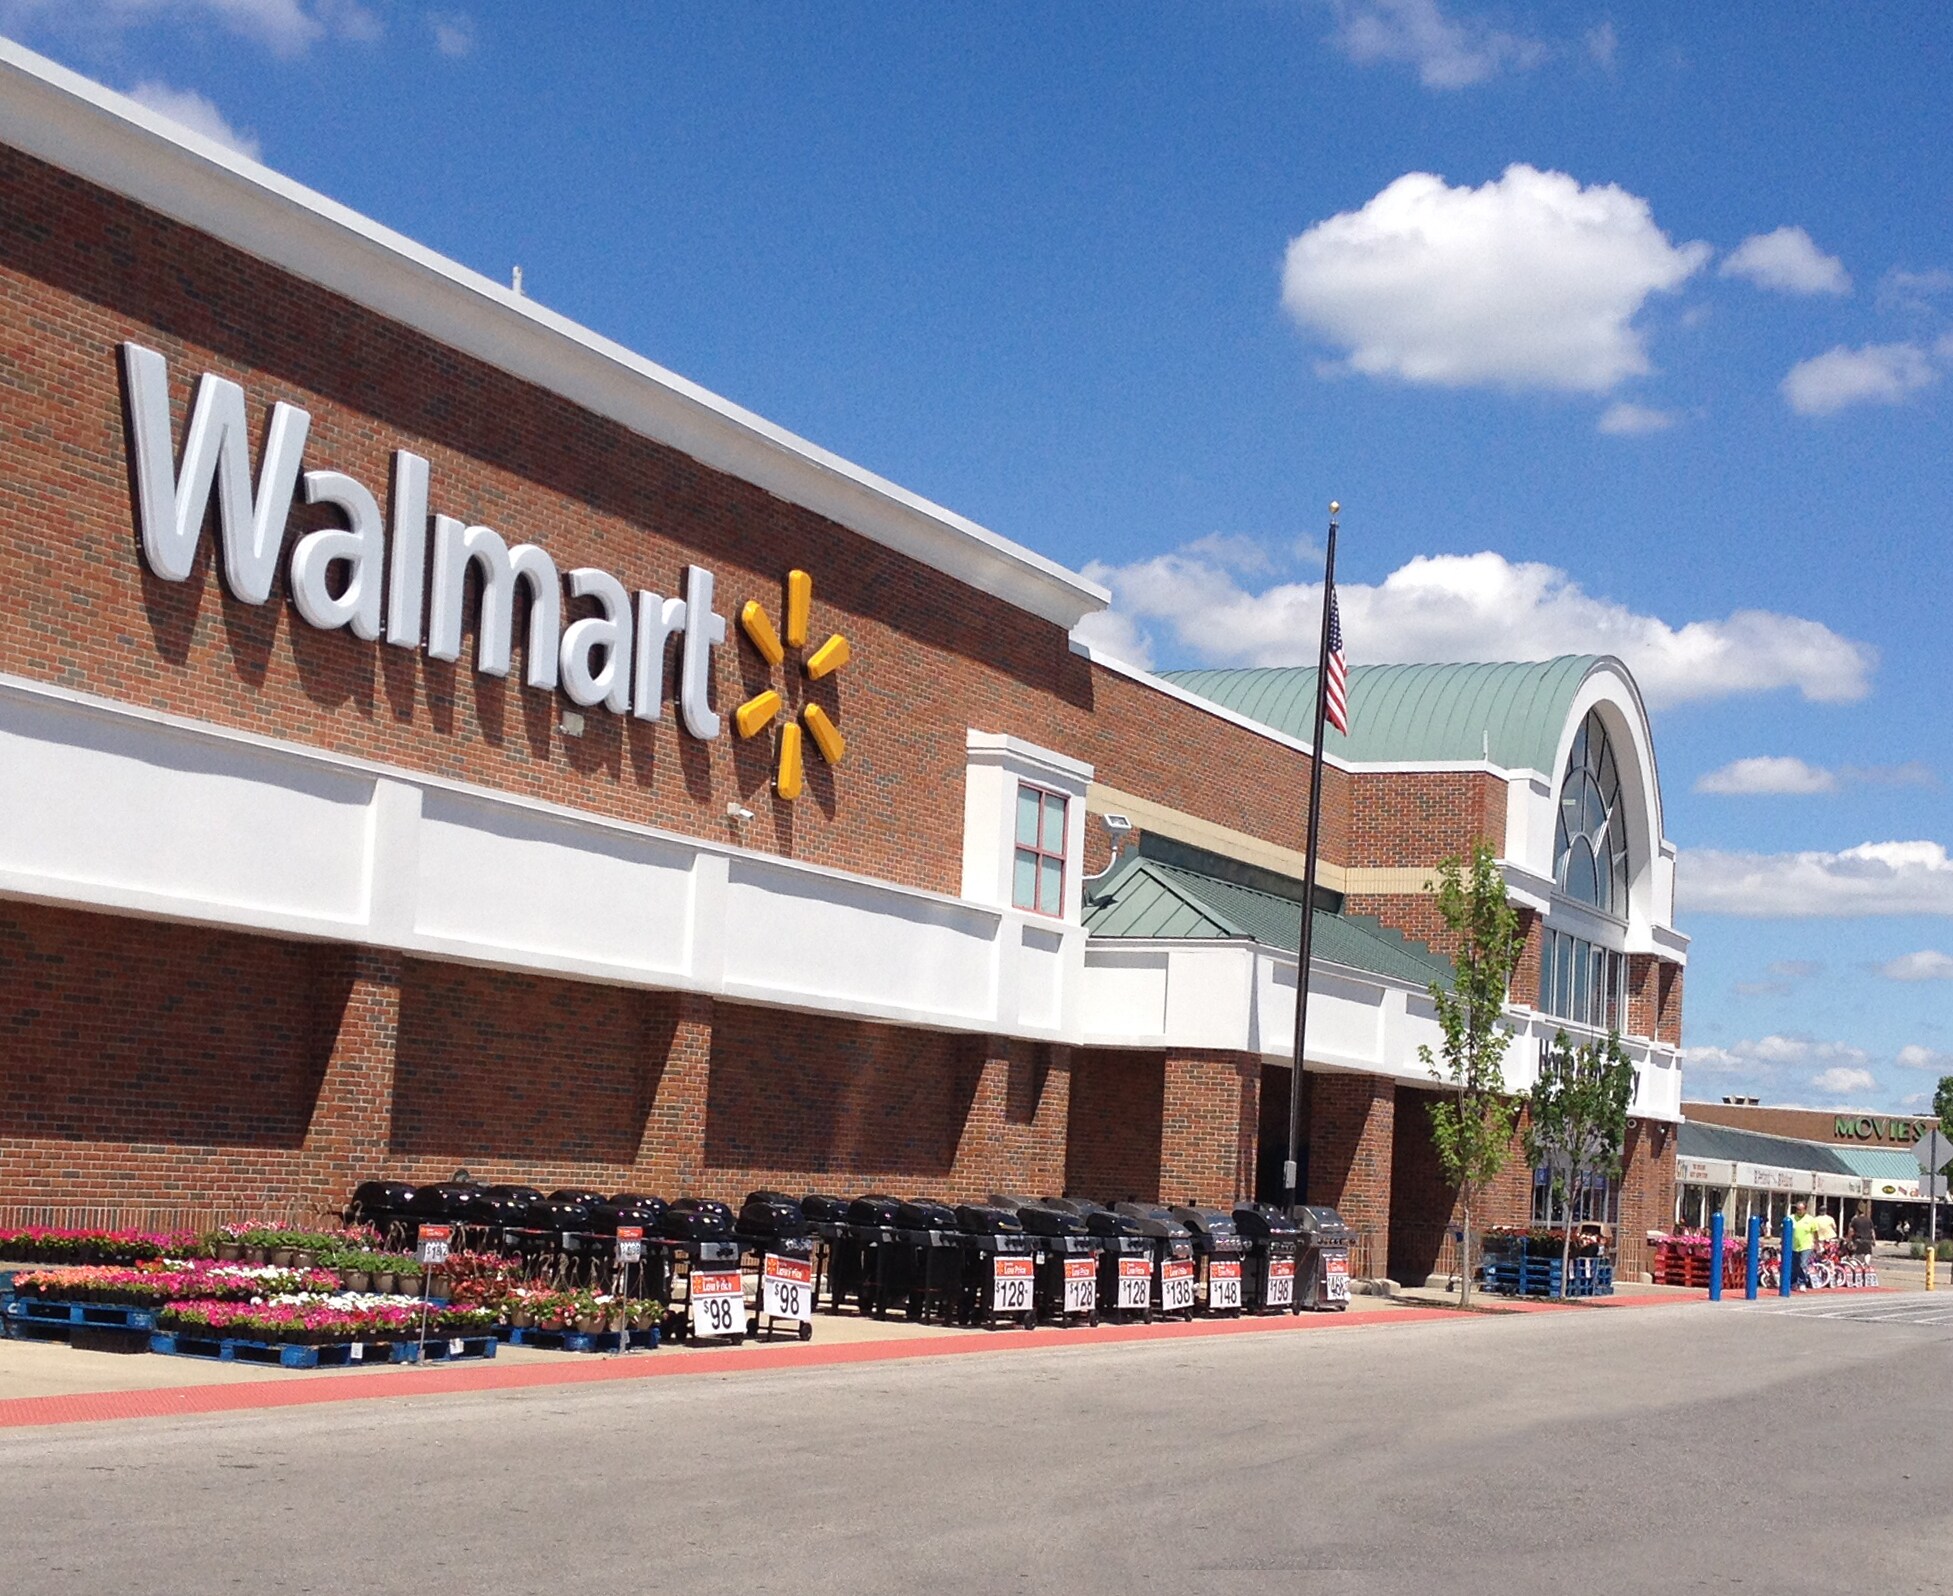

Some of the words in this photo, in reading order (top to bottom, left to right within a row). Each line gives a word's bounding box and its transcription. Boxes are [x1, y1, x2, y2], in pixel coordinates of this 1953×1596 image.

[123, 341, 726, 740] Walmart
[1834, 1117, 1927, 1142] MOVIES
[1004, 1265, 1015, 1275] Low
[1014, 1265, 1026, 1275] Price
[703, 1280, 716, 1291] Low
[716, 1279, 732, 1291] Price
[996, 1281, 1025, 1307] $128
[1070, 1281, 1093, 1307] $128
[1123, 1280, 1146, 1304] $128
[1166, 1281, 1190, 1305] $138
[1213, 1282, 1237, 1304] $148
[1269, 1280, 1289, 1301] $198
[774, 1283, 800, 1315] $98
[703, 1299, 732, 1330] $98
